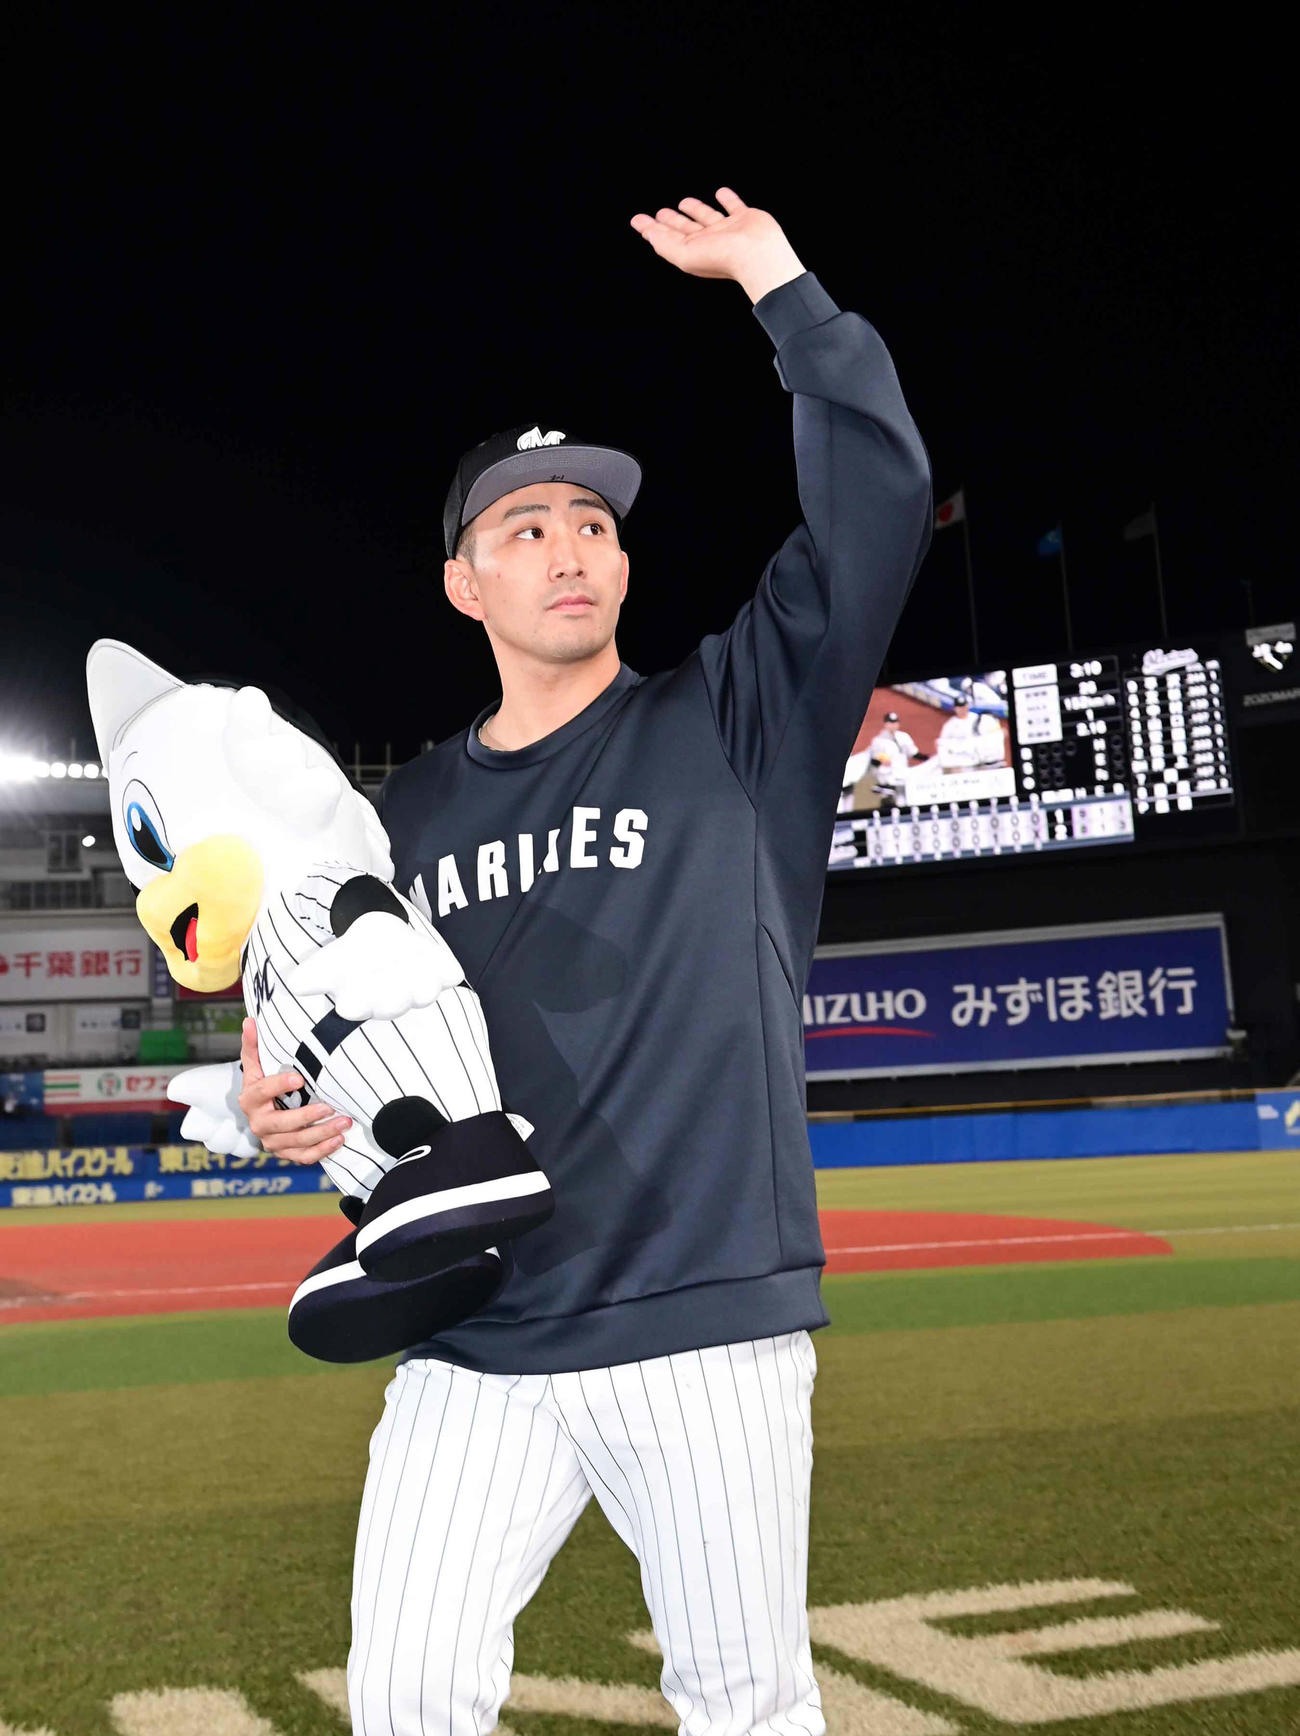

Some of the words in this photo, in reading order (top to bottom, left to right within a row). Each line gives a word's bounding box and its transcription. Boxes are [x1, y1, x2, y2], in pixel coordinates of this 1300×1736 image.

[14, 949, 142, 979] 千葉銀行
[951, 967, 1198, 1027] みずほ銀行
